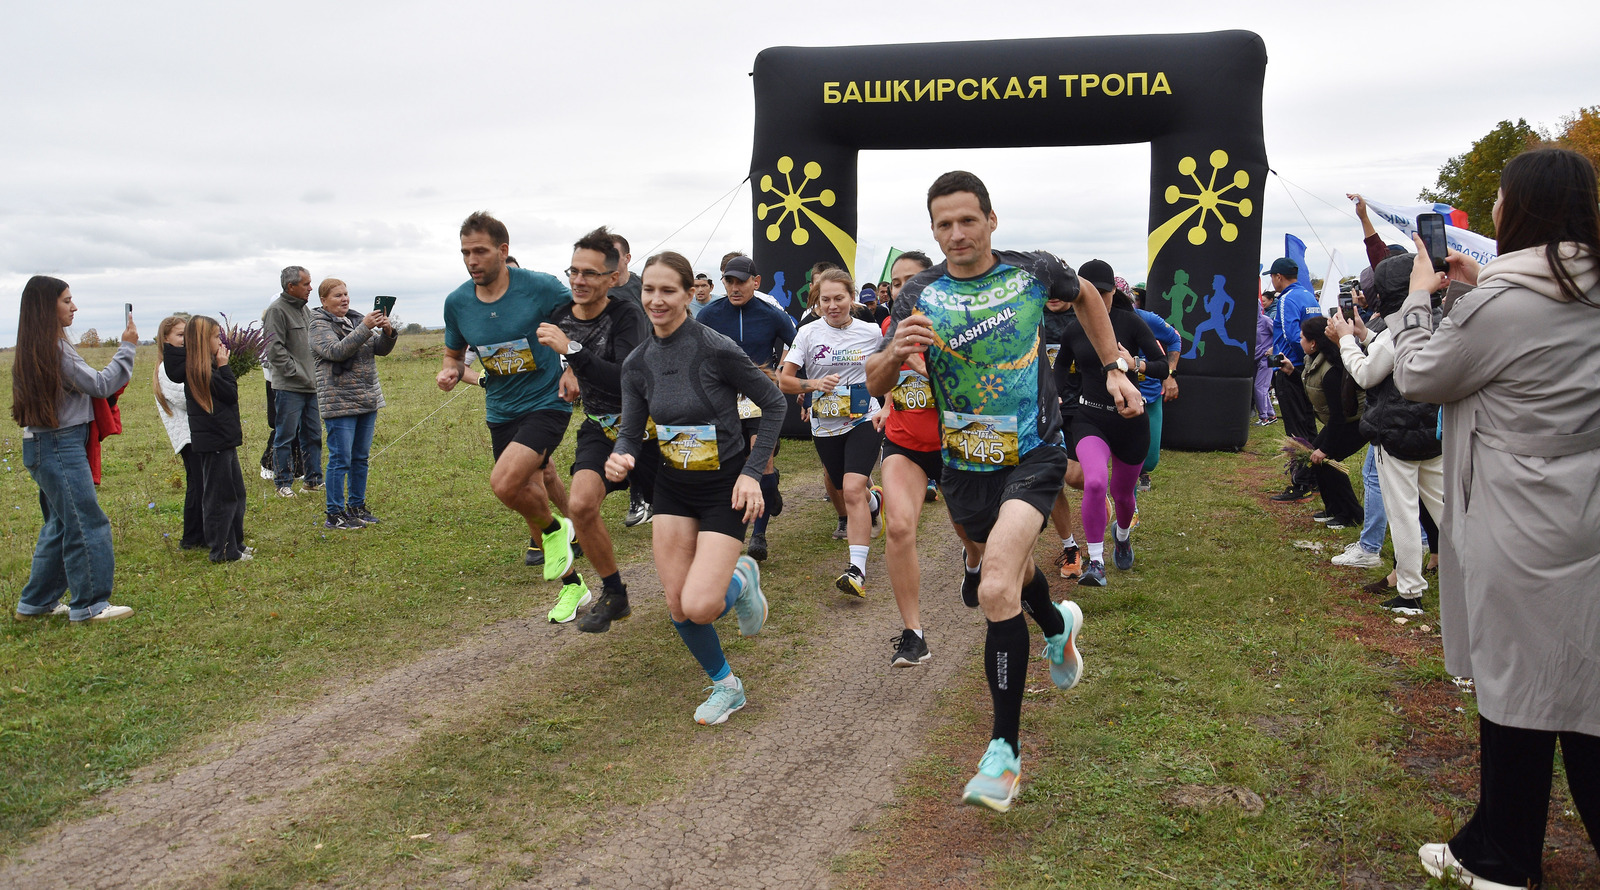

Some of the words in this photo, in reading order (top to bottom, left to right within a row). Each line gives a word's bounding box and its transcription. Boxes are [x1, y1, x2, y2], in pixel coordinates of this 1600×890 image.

[824, 75, 1047, 104] БАШКИРСКАЯ
[1058, 71, 1173, 98] ТРОПА
[949, 307, 1016, 350] BASHTRAIL
[494, 357, 527, 375] 172
[821, 402, 839, 417] 48
[905, 390, 927, 409] 60
[678, 449, 692, 469] 7
[959, 439, 1005, 464] 145
